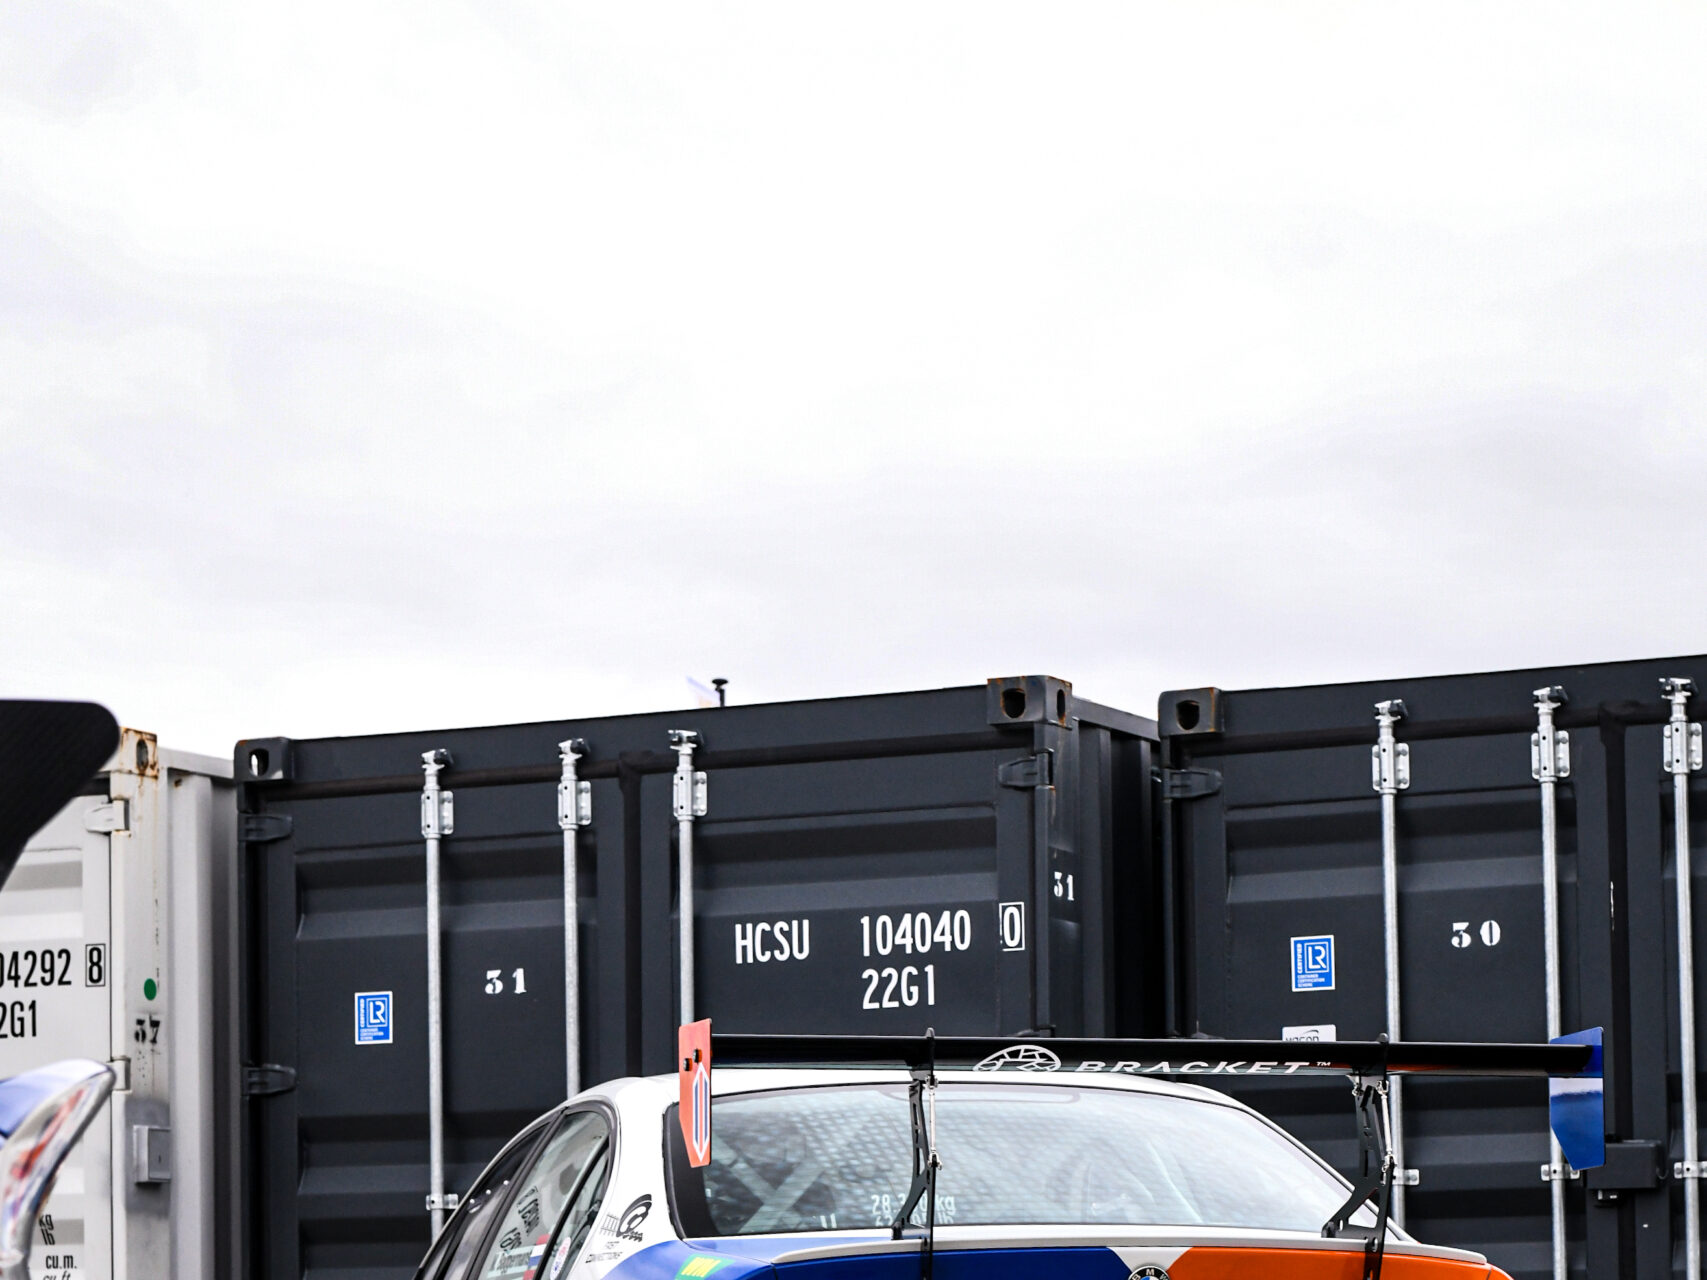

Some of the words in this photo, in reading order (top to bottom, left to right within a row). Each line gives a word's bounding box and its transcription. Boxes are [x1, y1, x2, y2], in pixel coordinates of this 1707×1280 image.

[1054, 871, 1076, 901] 31
[735, 919, 810, 964] HCSU
[860, 909, 971, 957] 104040
[1003, 906, 1021, 948] 0
[1451, 920, 1501, 948] 30
[88, 947, 103, 984] 8
[485, 968, 527, 994] 31
[861, 964, 935, 1010] 22G1
